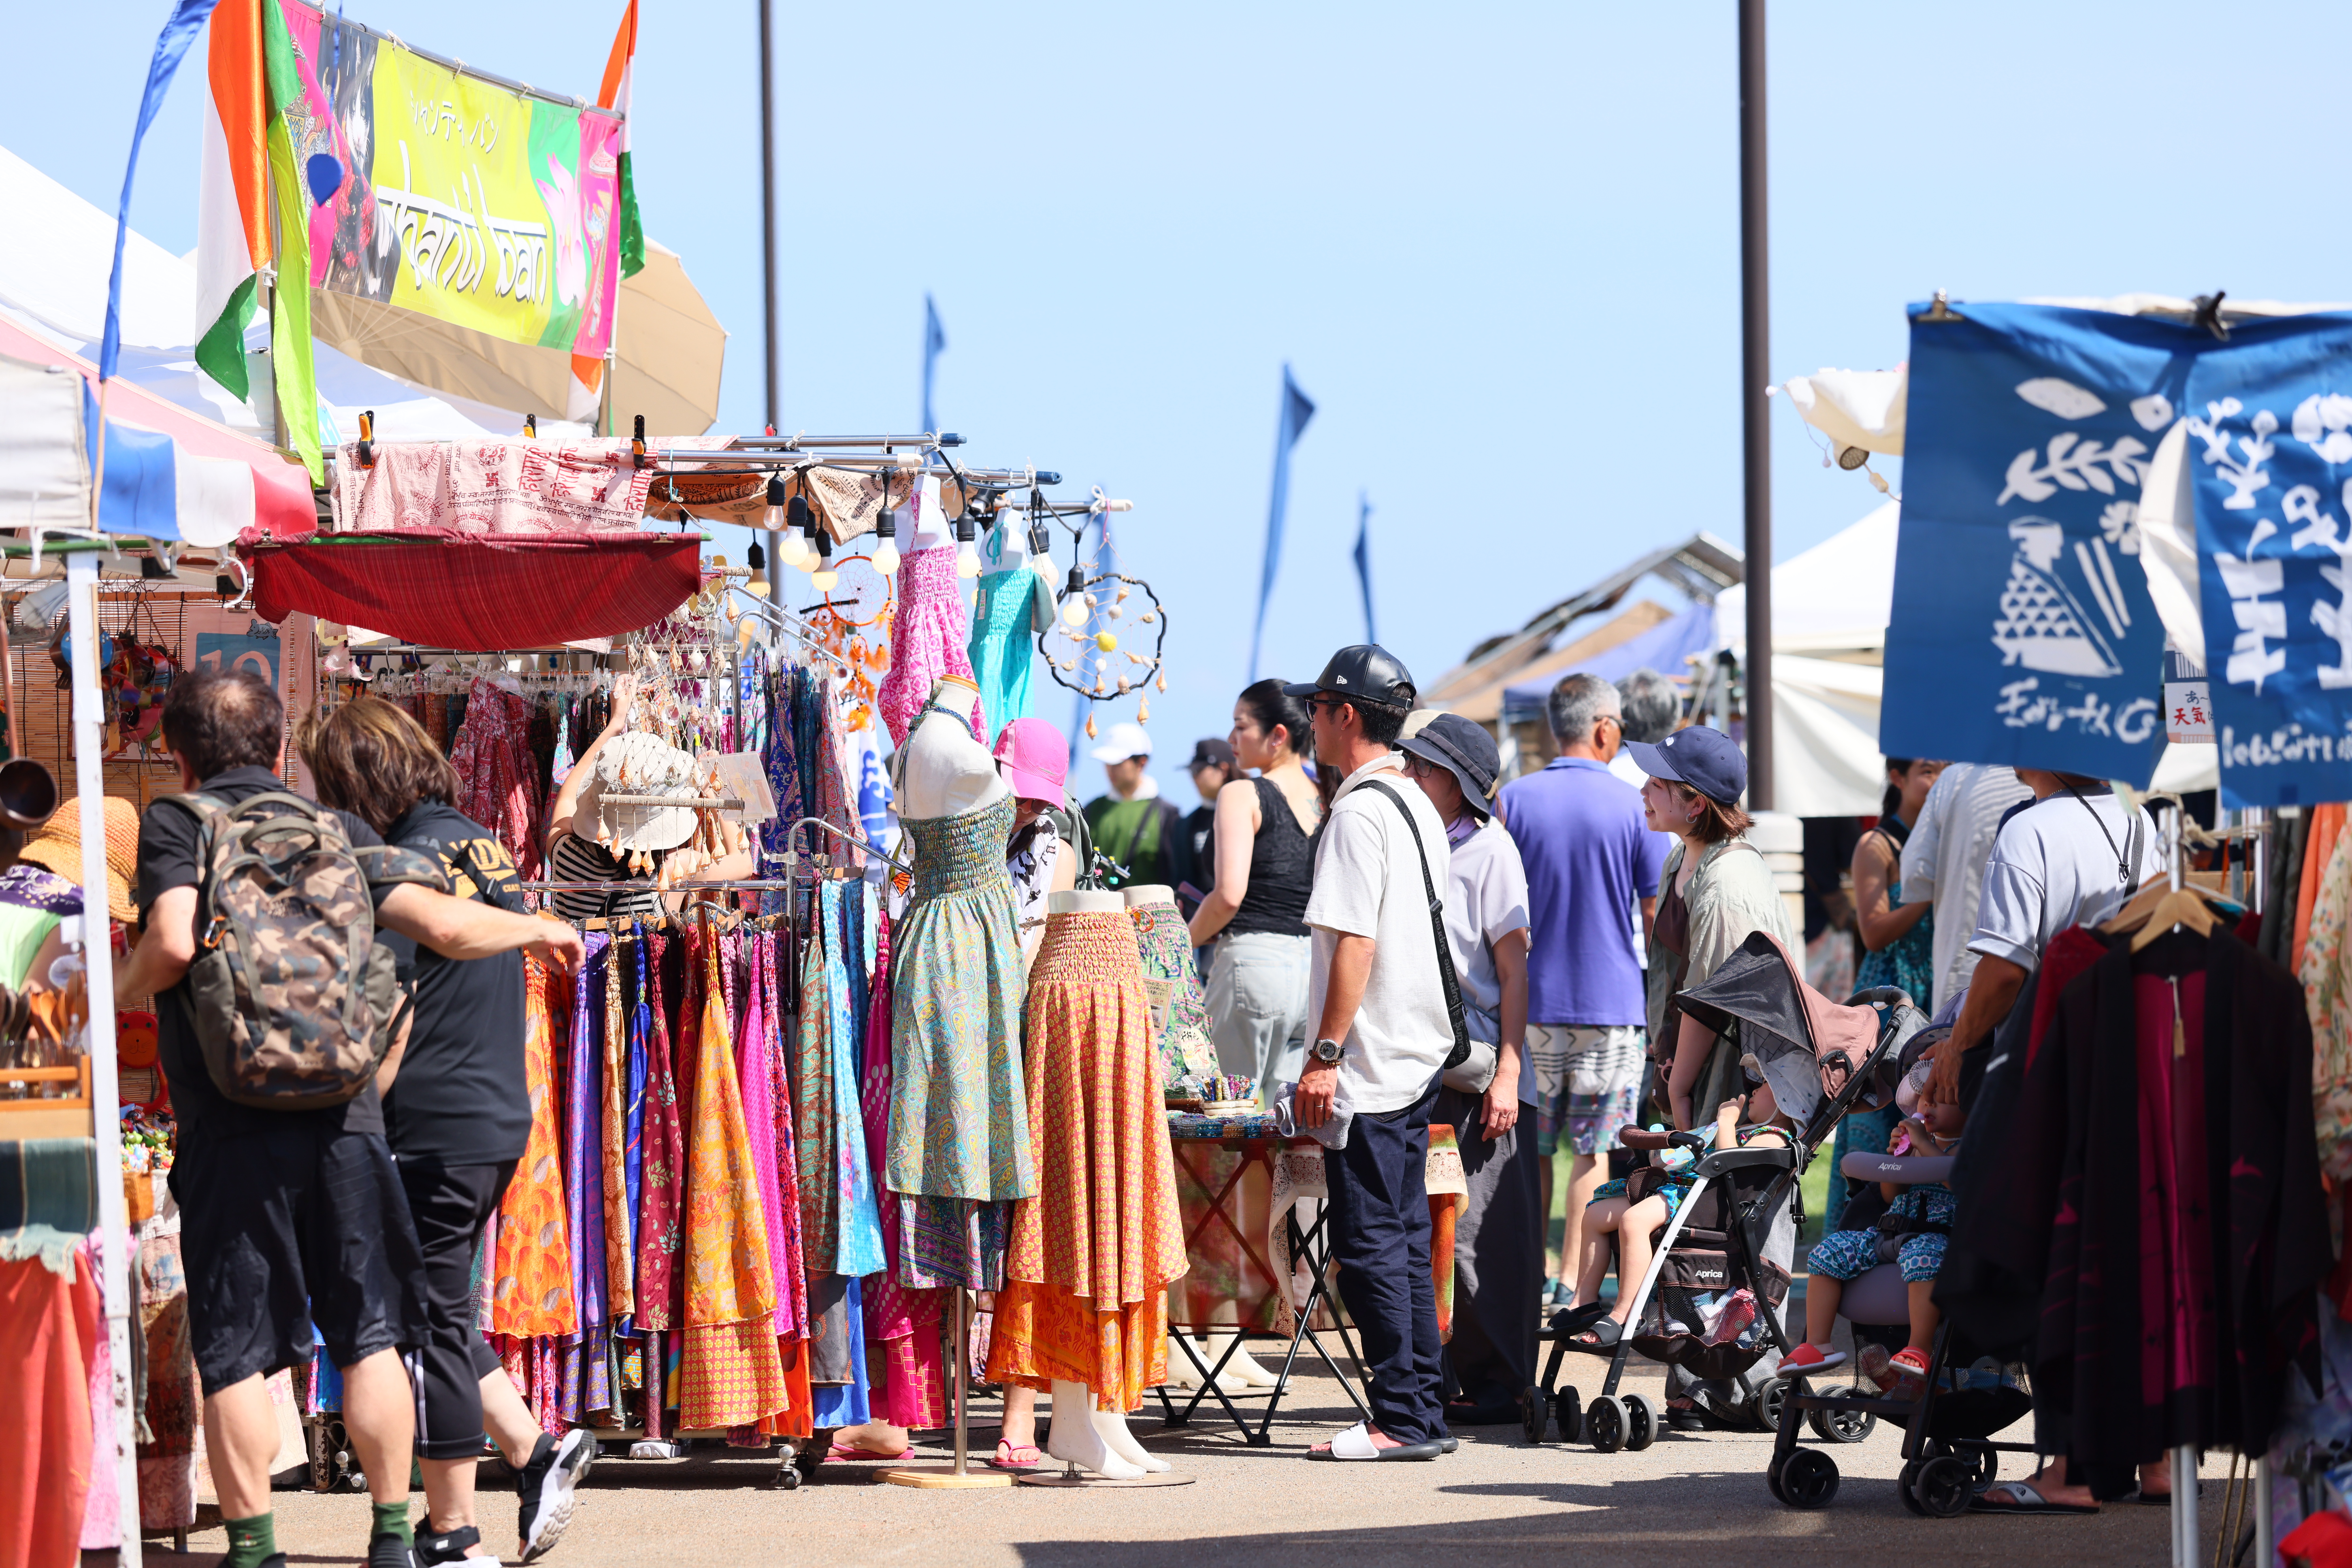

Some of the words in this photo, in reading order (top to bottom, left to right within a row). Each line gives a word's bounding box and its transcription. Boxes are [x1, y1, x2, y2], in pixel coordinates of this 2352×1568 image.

[473, 164, 547, 305] ban
[1444, 958, 1459, 1005] Supreme
[1878, 1162, 1902, 1171] Aprica
[1695, 1269, 1723, 1278] Aprica
